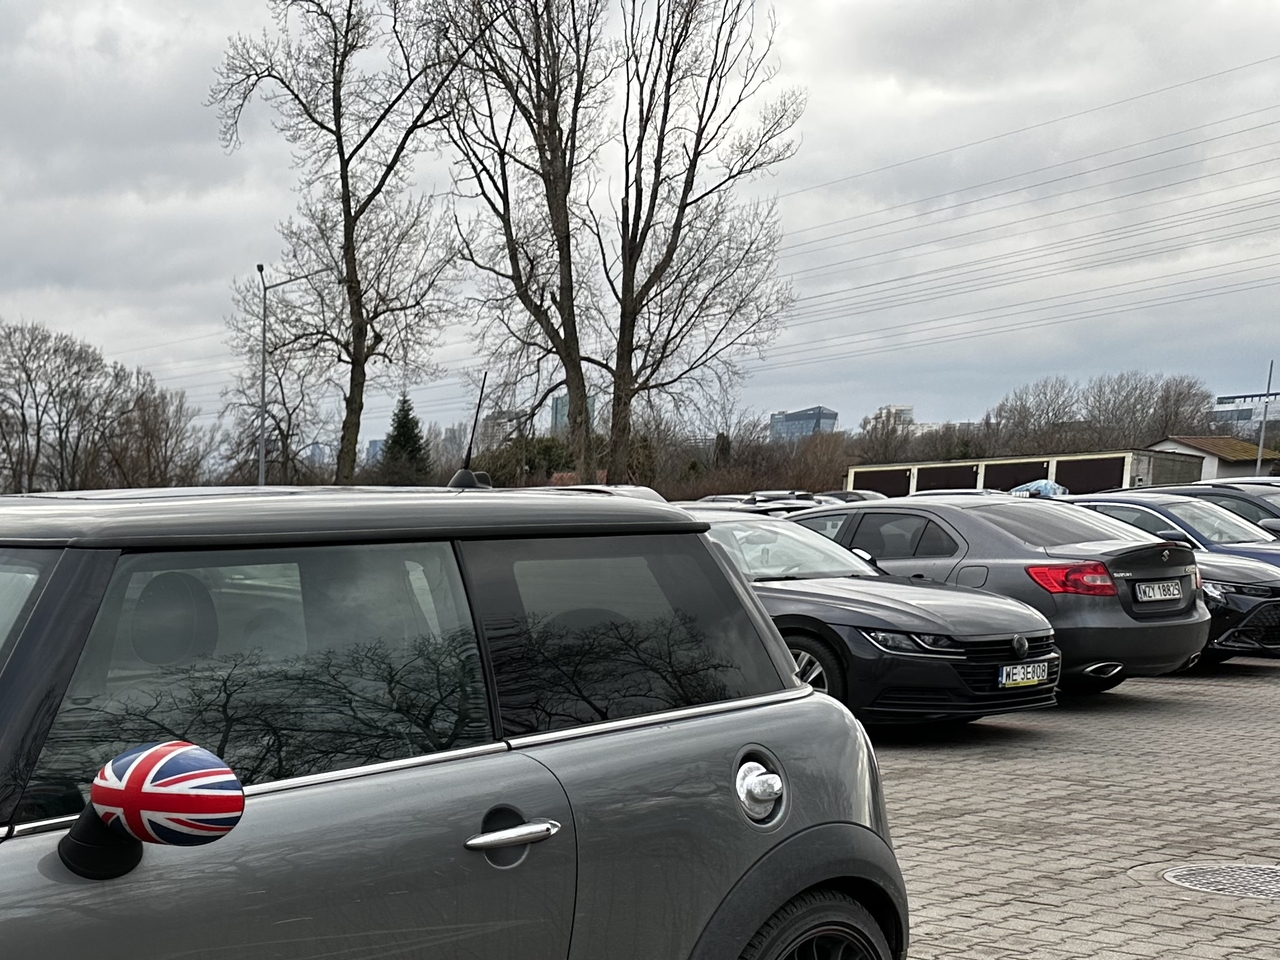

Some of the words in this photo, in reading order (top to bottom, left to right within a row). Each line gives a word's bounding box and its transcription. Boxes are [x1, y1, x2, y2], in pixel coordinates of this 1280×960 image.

[1141, 585, 1156, 598] WZY
[1005, 666, 1018, 682] WE
[1020, 663, 1046, 681] 3E808
